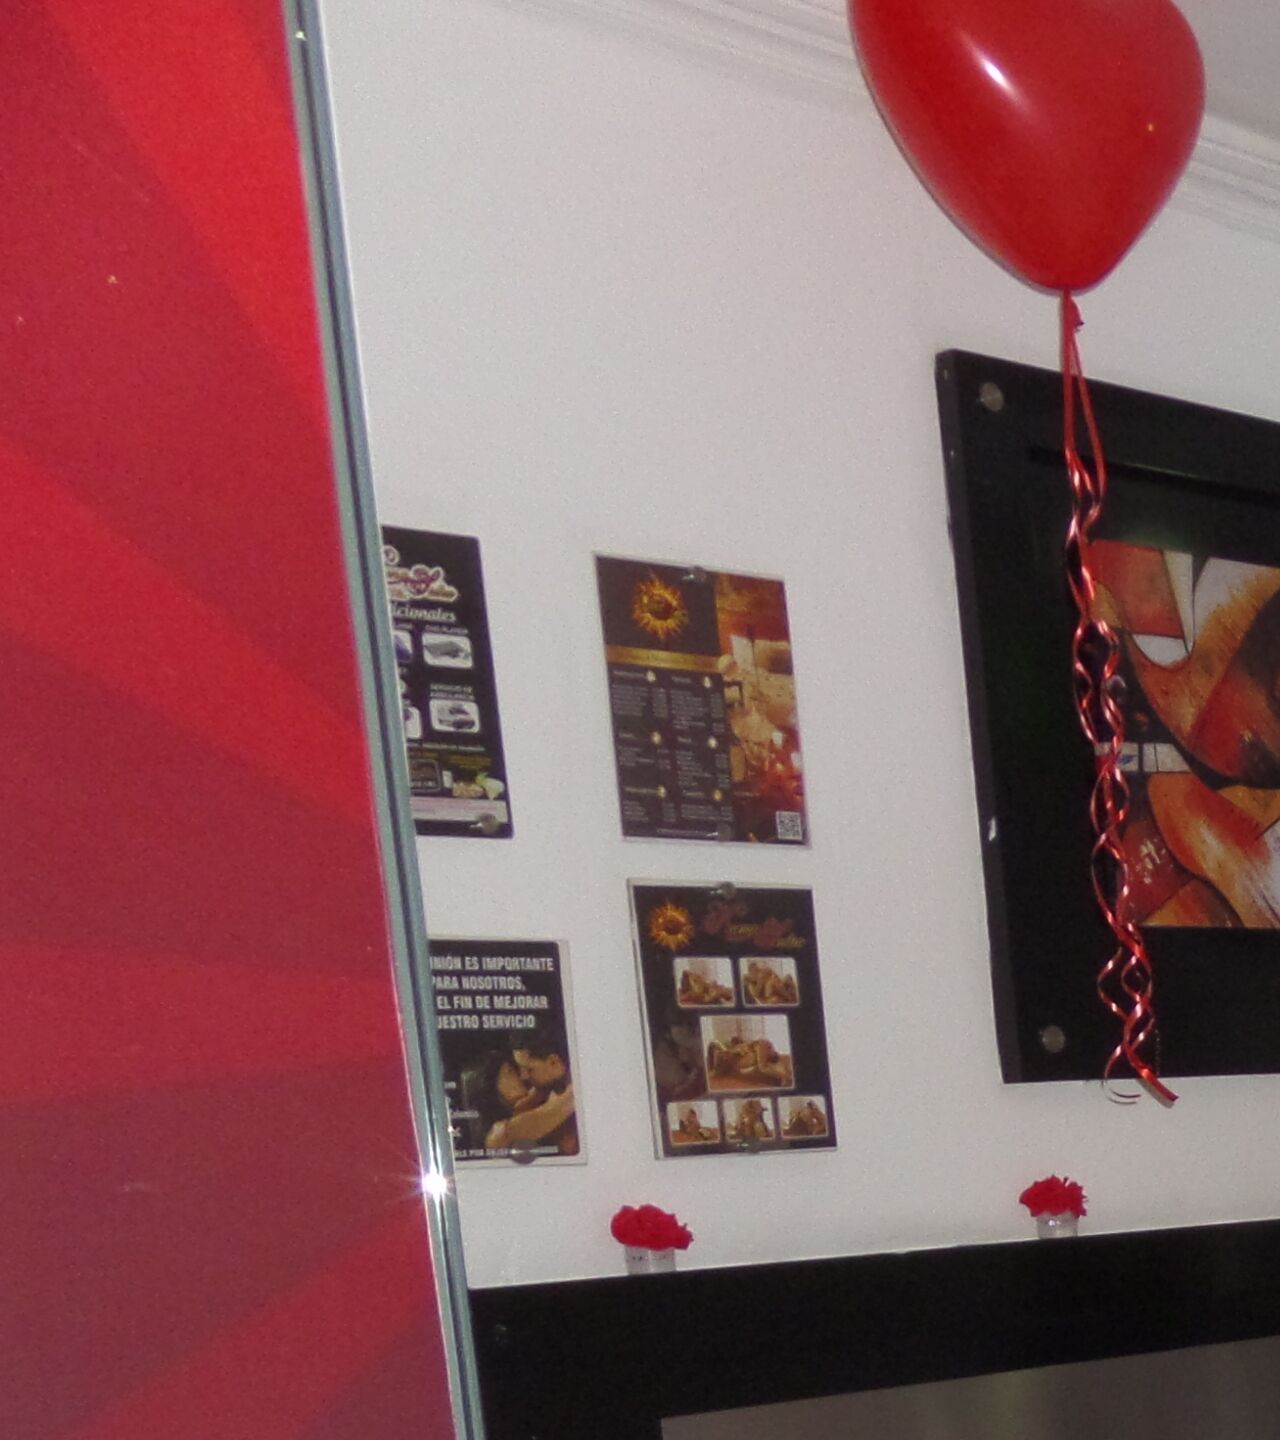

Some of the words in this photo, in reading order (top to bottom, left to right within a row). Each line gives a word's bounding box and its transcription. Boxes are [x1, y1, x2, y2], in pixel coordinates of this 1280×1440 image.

[429, 954, 462, 971] INIÓN
[464, 956, 480, 970] ES
[482, 956, 554, 971] IMPORTANTE
[437, 995, 451, 1009] EL
[453, 995, 473, 1009] FIN
[475, 995, 491, 1009] DE
[493, 995, 549, 1009] MEJORAR
[437, 1014, 480, 1029] UESTRO
[482, 1014, 536, 1029] SERVICIO
